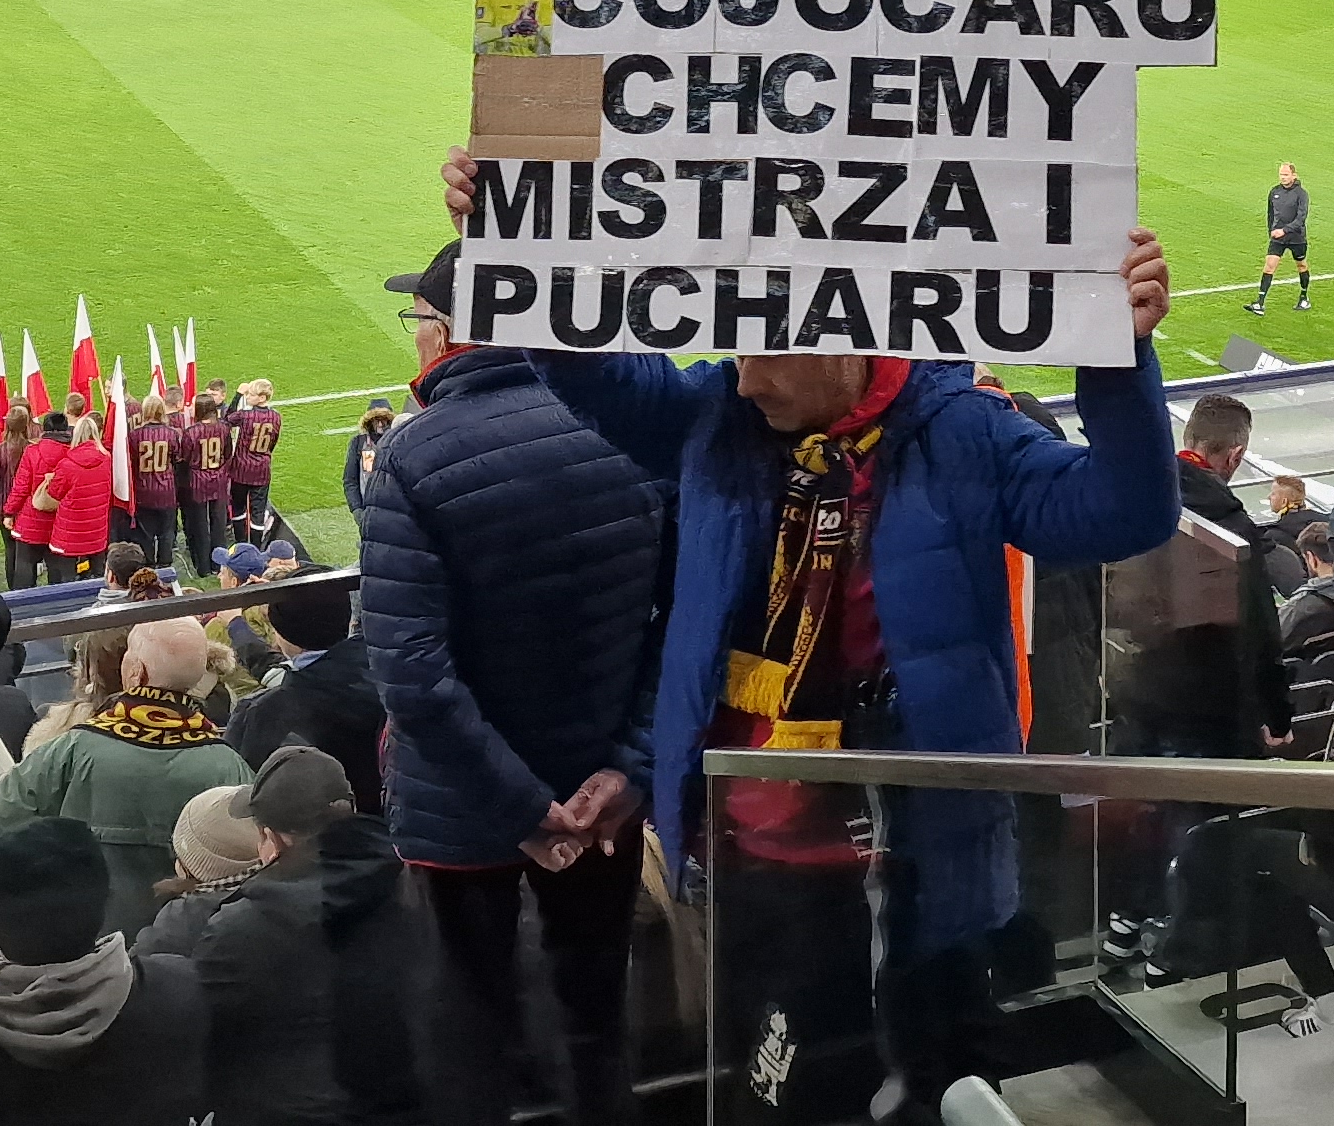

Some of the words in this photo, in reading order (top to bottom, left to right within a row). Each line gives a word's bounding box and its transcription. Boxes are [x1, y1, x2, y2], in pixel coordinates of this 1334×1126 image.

[603, 53, 1107, 141] CHCEMY
[467, 158, 999, 244] MISTRZA
[1045, 163, 1072, 245] I
[470, 264, 1054, 352] PUCHARU
[199, 437, 221, 470] 19
[249, 422, 273, 453] 16
[139, 440, 169, 473] 20
[128, 686, 176, 703] UMA
